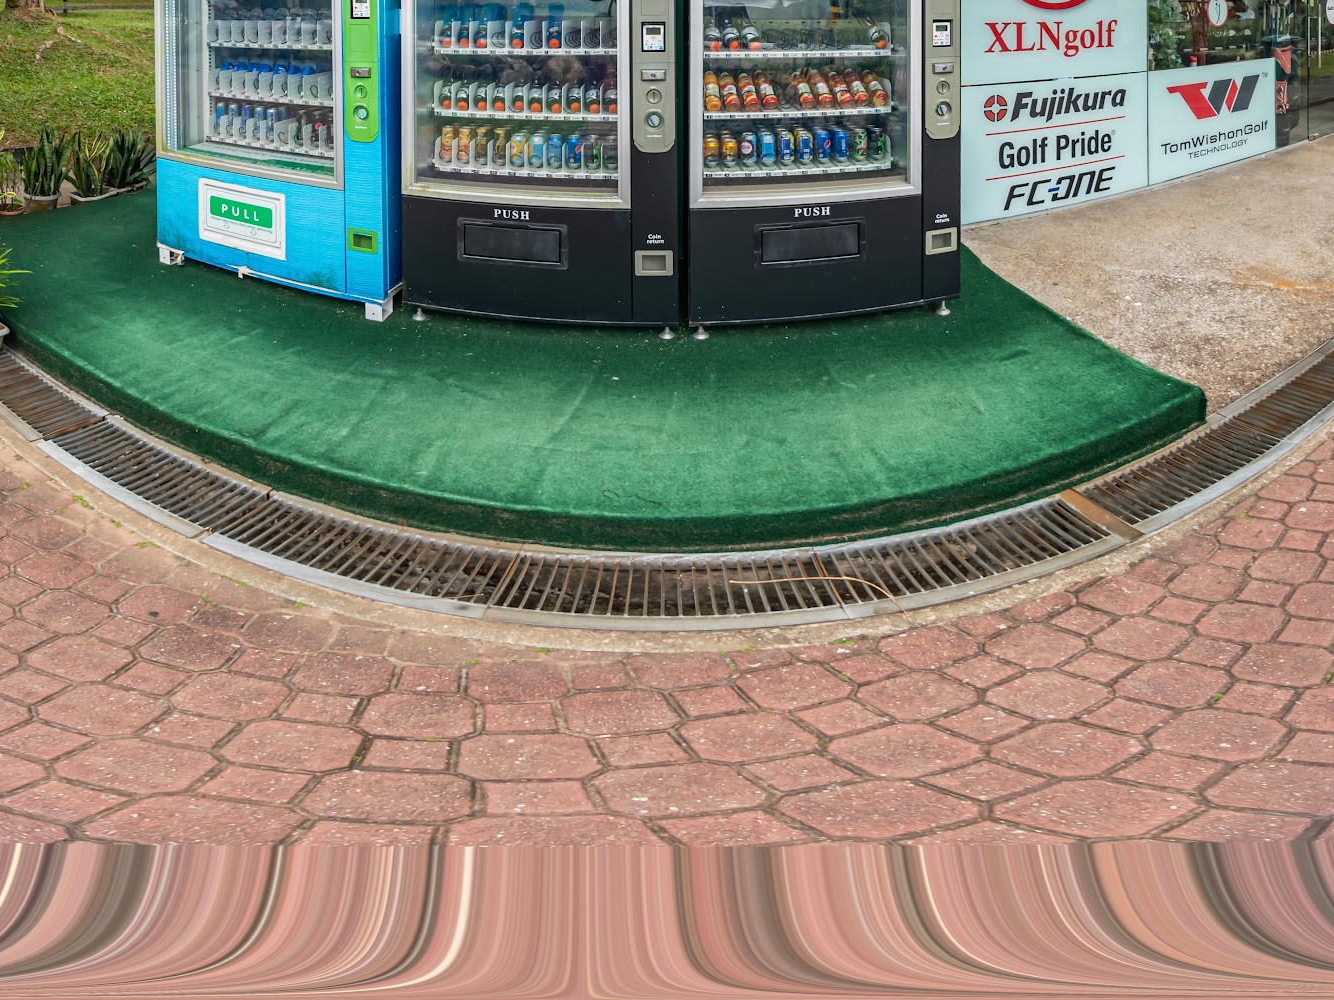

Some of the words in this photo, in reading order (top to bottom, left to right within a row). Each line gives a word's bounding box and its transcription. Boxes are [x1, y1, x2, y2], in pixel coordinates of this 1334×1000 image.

[984, 19, 1117, 57] XLNgolf
[1010, 87, 1126, 123] Fujikura
[1161, 120, 1268, 155] TomWishonGolf
[1187, 138, 1249, 159] TECHNOLOGY
[998, 136, 1048, 169] Golf
[221, 203, 260, 222] PULL
[493, 208, 530, 220] PUSH
[794, 206, 831, 218] PUSH
